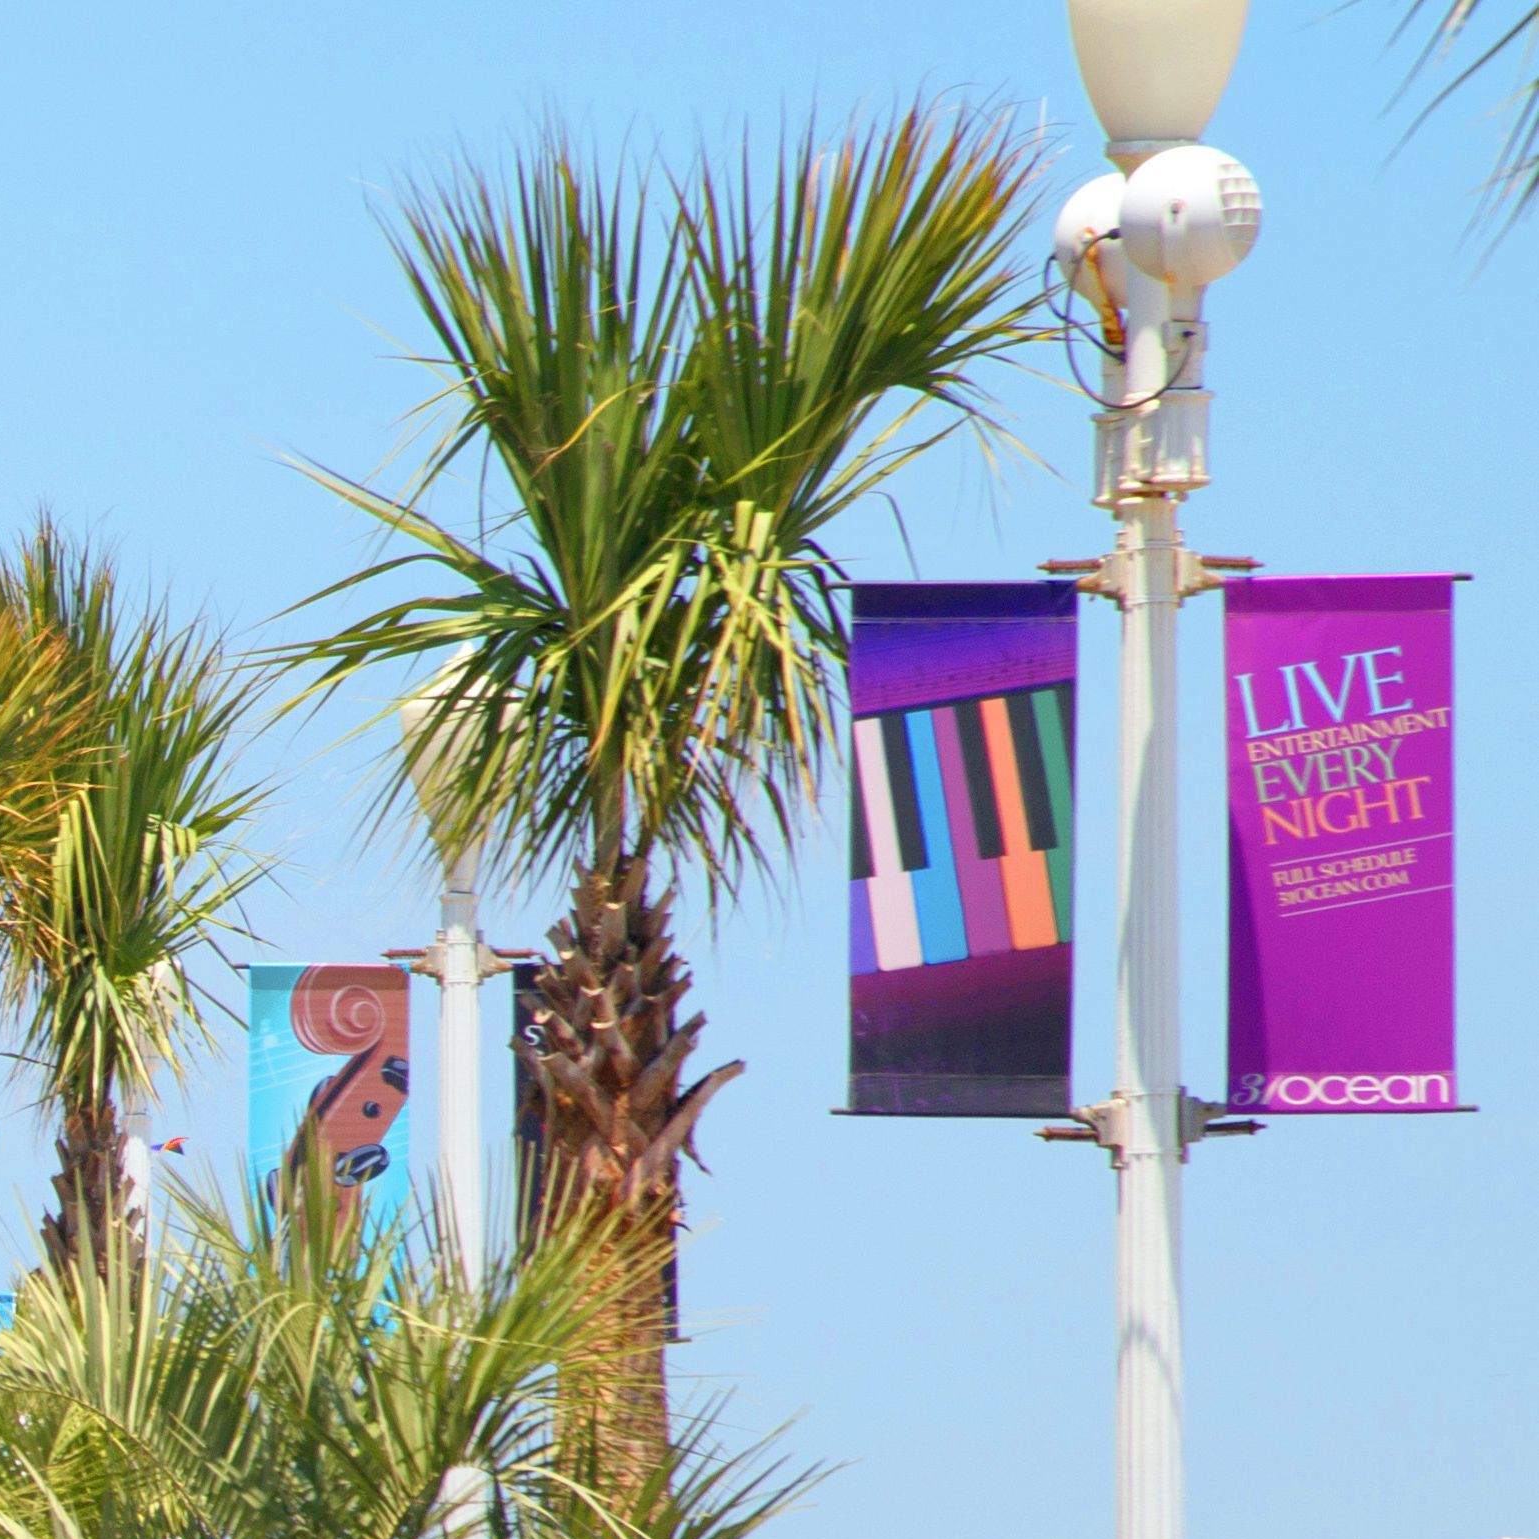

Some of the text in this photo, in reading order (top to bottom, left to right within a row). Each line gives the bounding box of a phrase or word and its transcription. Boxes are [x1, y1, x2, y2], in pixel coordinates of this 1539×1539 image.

[1233, 646, 1413, 739] LIVE
[1246, 706, 1452, 763] ENTERTAINMENT
[1252, 738, 1403, 804] EVERY
[1261, 775, 1432, 845] NIGHT
[1273, 847, 1418, 887] FULL SCHEDULE
